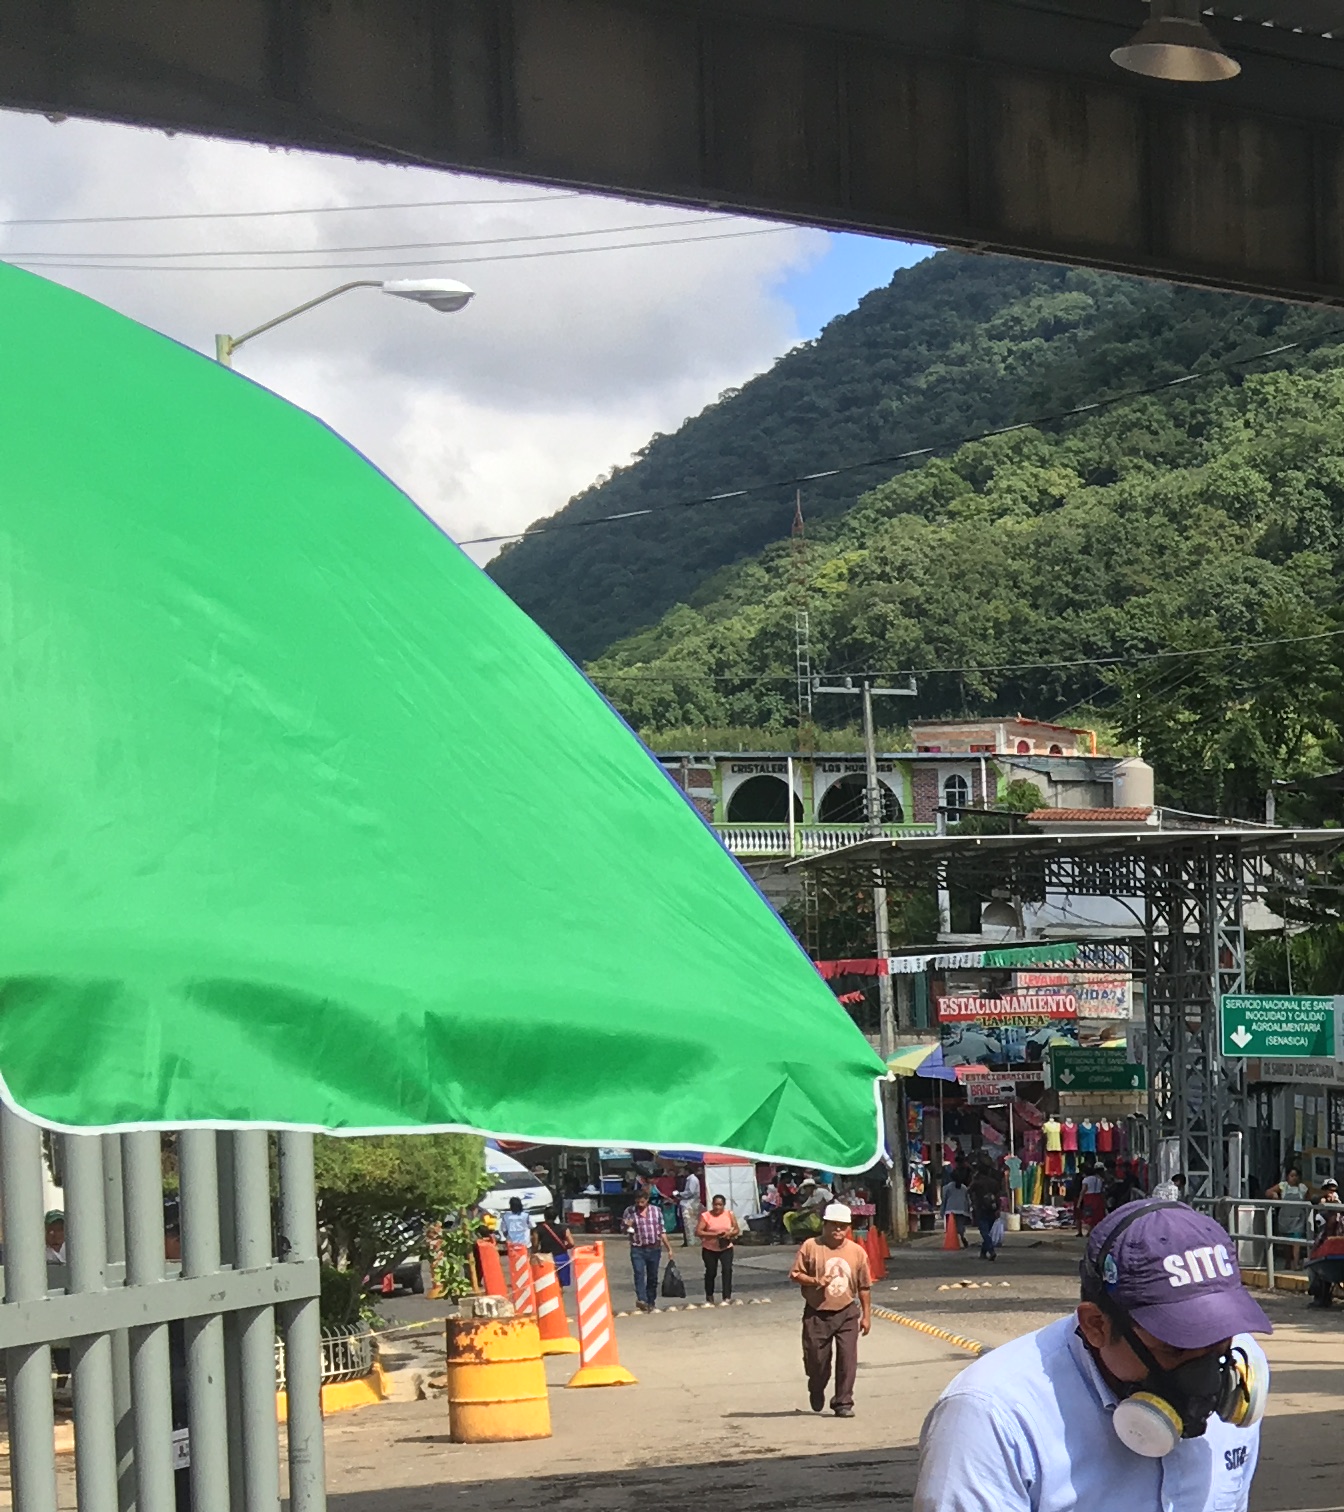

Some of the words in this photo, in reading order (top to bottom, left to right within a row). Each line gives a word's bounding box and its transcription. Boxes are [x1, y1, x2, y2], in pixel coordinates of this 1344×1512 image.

[731, 763, 789, 775] CRISTALERI
[940, 995, 1076, 1015] ESTACIONAMIENTO
[1225, 999, 1262, 1010] SERVICIO
[1262, 999, 1300, 1010] NACIONAL
[1301, 1000, 1312, 1010] DE
[1245, 1011, 1287, 1021] INOCUIDAD
[1287, 1011, 1294, 1021] Y
[1294, 1011, 1326, 1021] CALIDAD
[1251, 1022, 1322, 1033] AGROALIMENTARIA
[1265, 1035, 1309, 1047] (SENASICA)
[1162, 1244, 1234, 1288] SITC
